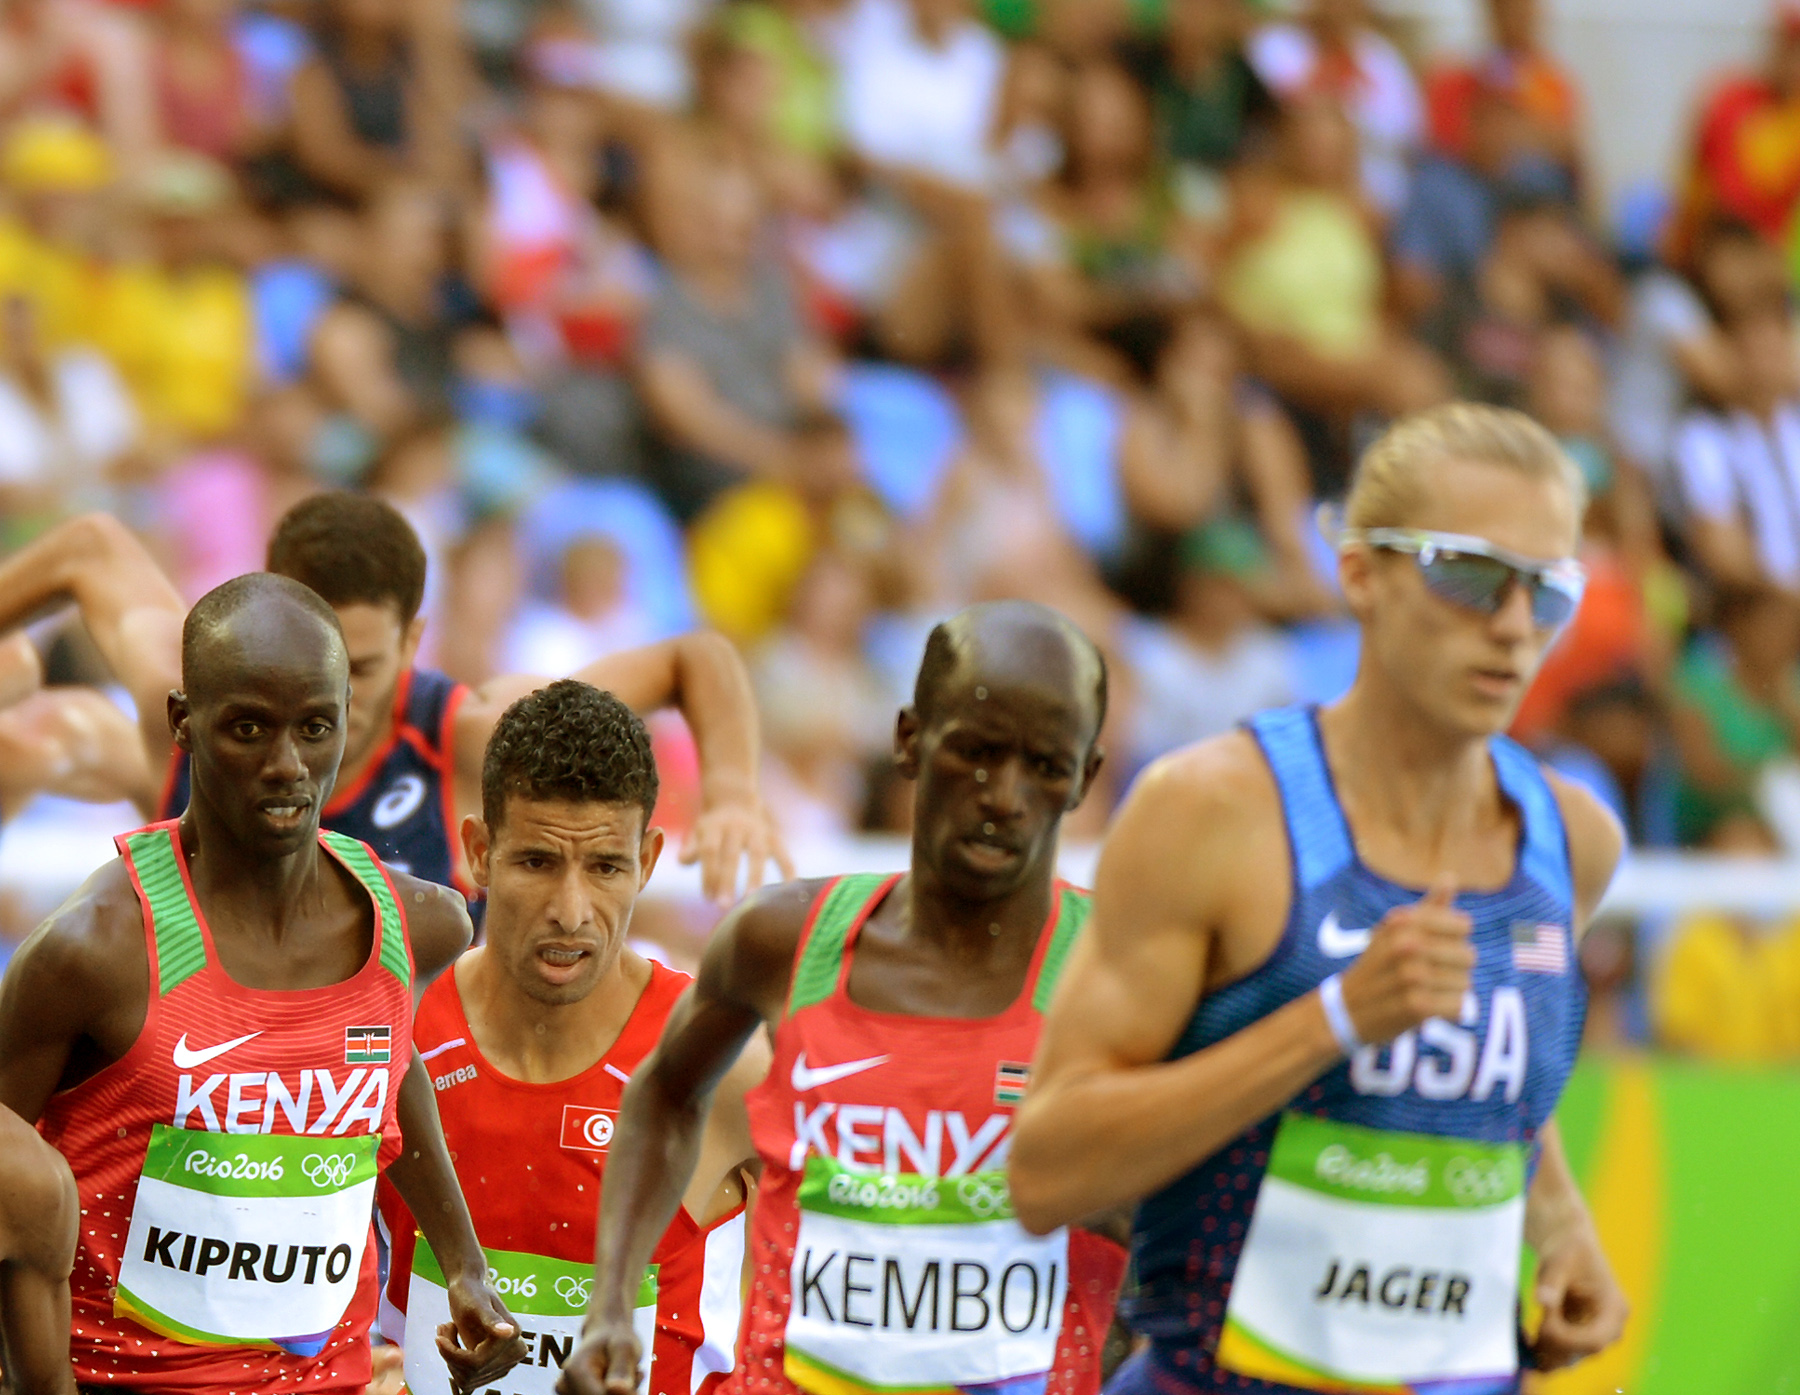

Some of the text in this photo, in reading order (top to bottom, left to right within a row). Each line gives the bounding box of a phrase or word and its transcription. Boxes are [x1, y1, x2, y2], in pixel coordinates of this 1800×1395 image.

[173, 1068, 389, 1135] KENYA
[184, 1149, 284, 1181] Rio2016
[828, 1173, 940, 1210] Rio2016
[143, 1226, 352, 1285] KIPRUTO
[801, 1249, 1058, 1334] KEMBOI
[1316, 1258, 1472, 1317] JAGER
[519, 1330, 575, 1370] EN
